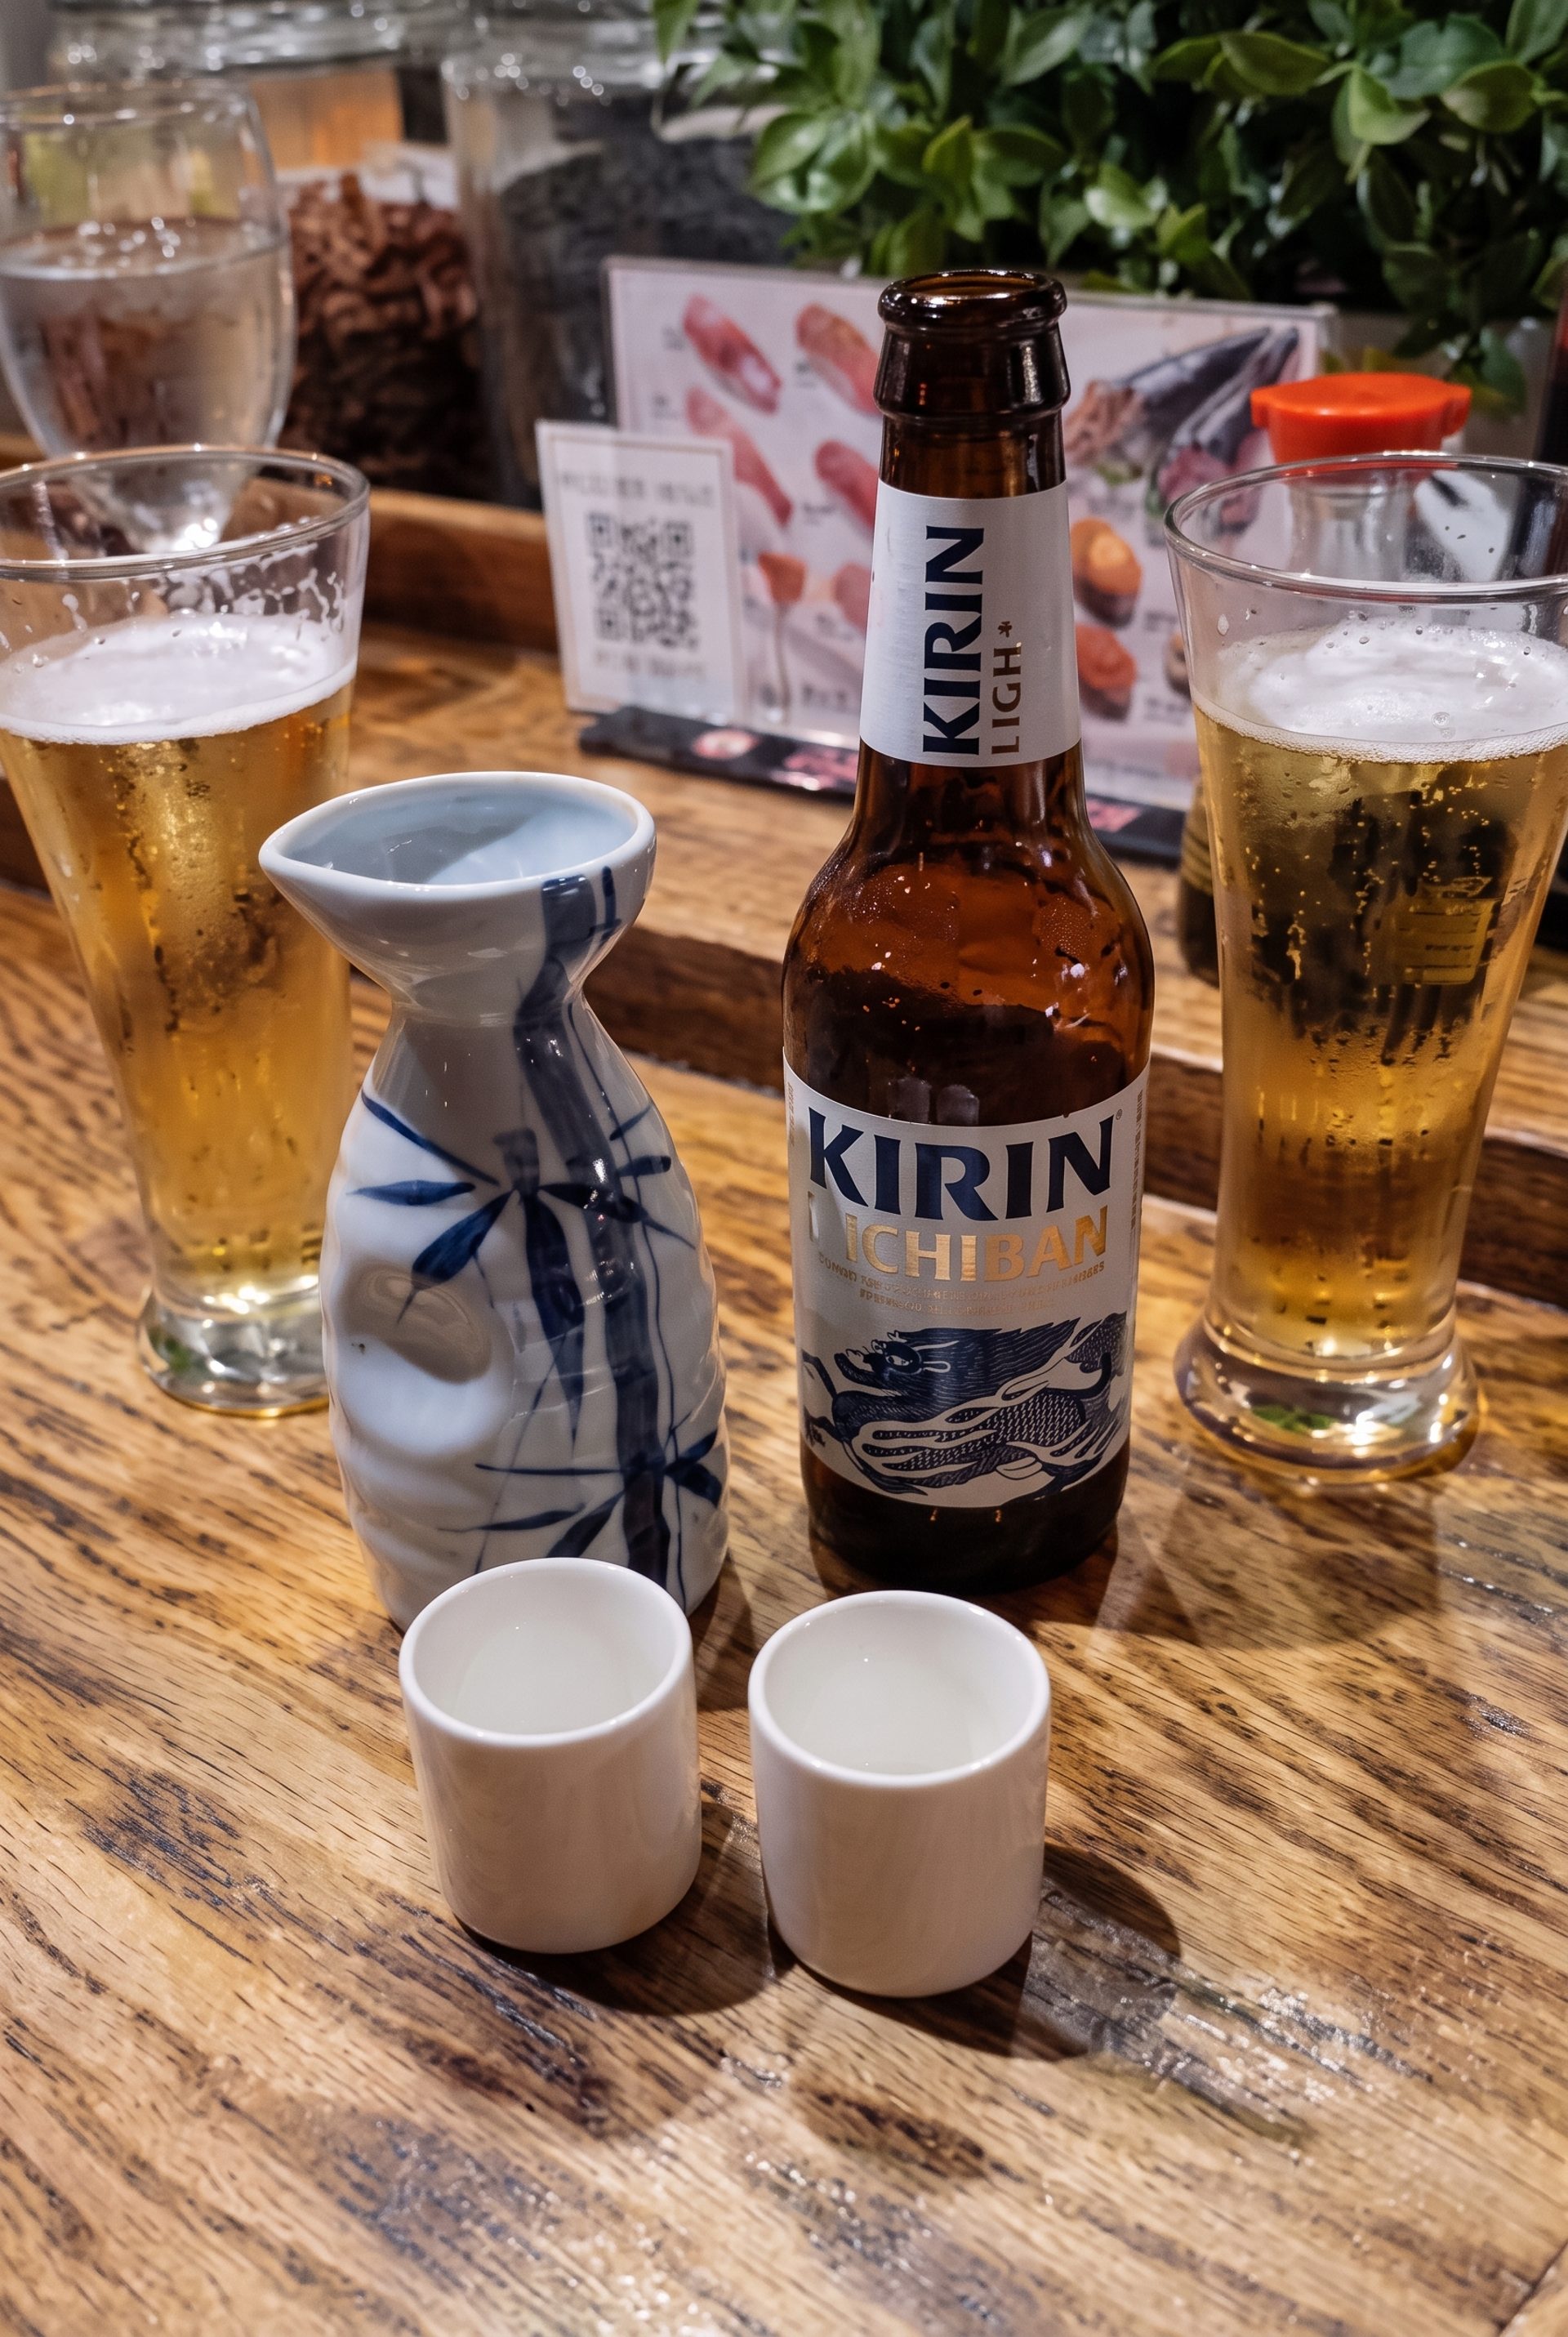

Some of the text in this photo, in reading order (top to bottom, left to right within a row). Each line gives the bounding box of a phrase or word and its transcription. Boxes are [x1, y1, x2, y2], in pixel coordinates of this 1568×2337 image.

[923, 525, 984, 756] KIRIN
[808, 1107, 1115, 1222] KIRIN
[844, 1204, 1108, 1283] ICHIBAN
